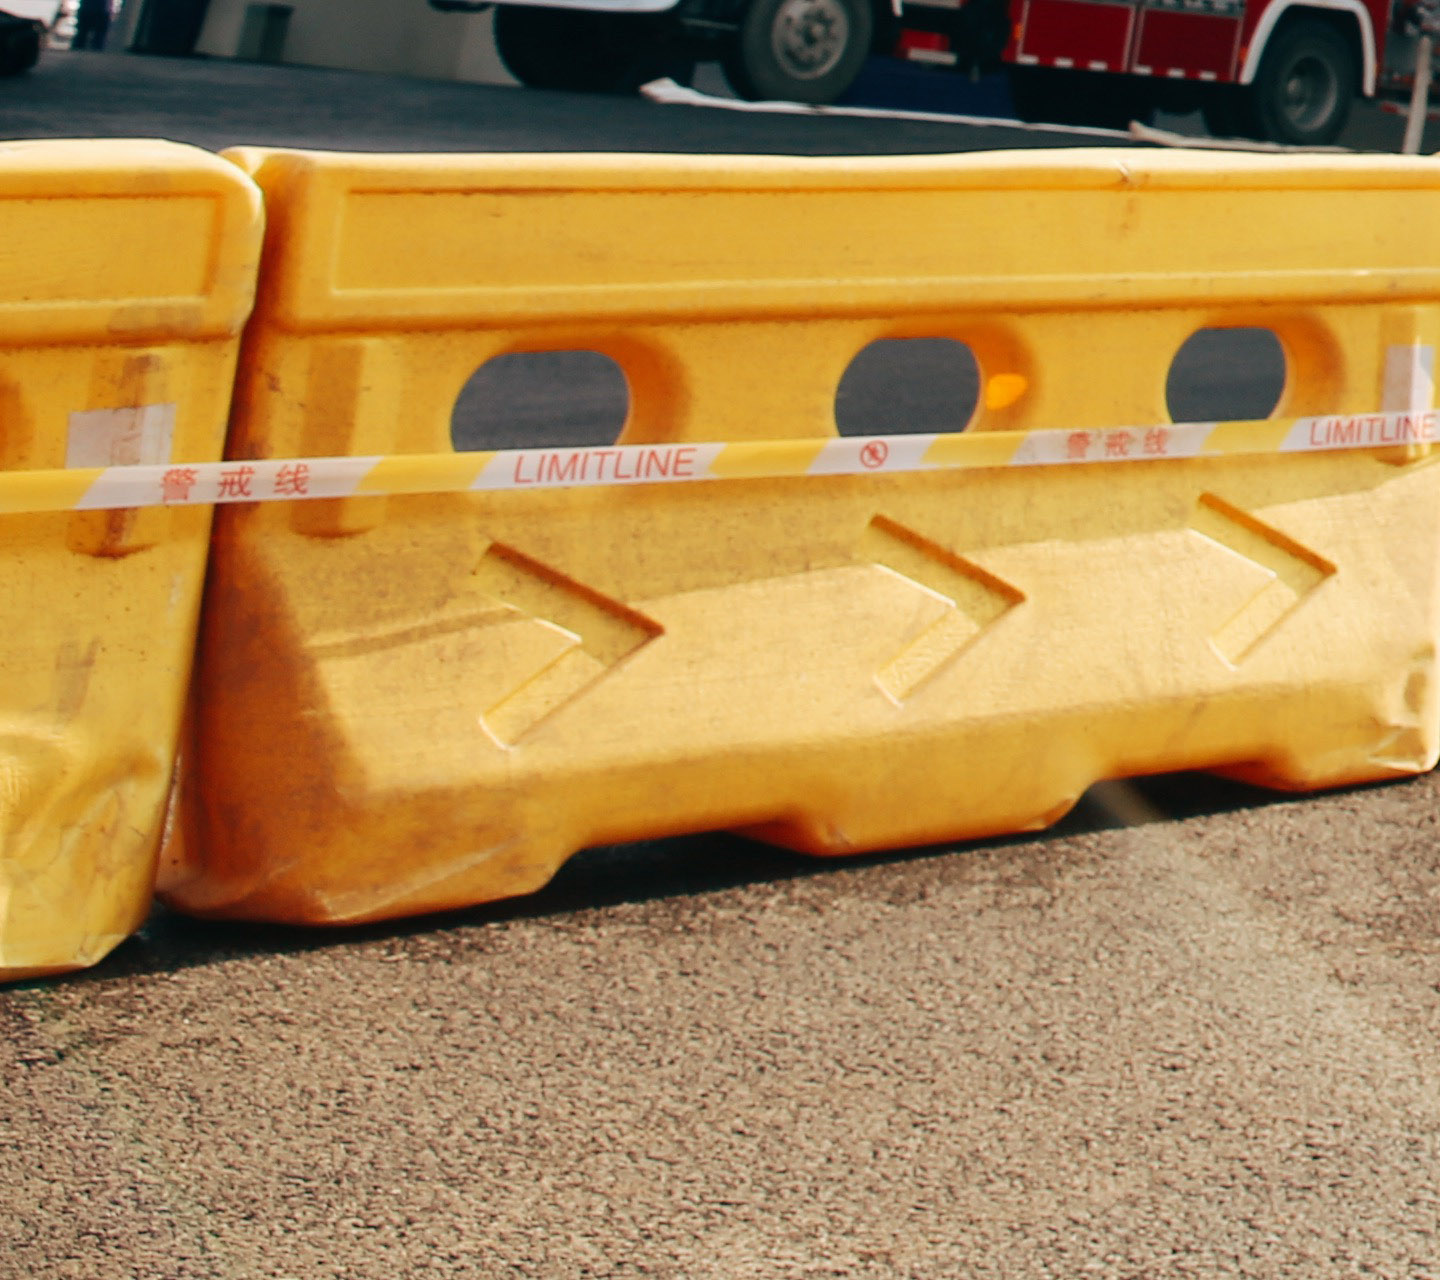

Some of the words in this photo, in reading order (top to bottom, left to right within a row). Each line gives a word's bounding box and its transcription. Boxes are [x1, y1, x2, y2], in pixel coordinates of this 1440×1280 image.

[1308, 413, 1438, 446] LIMITLINE
[159, 463, 311, 502] 警戒线
[513, 447, 698, 484] LIMITLINE
